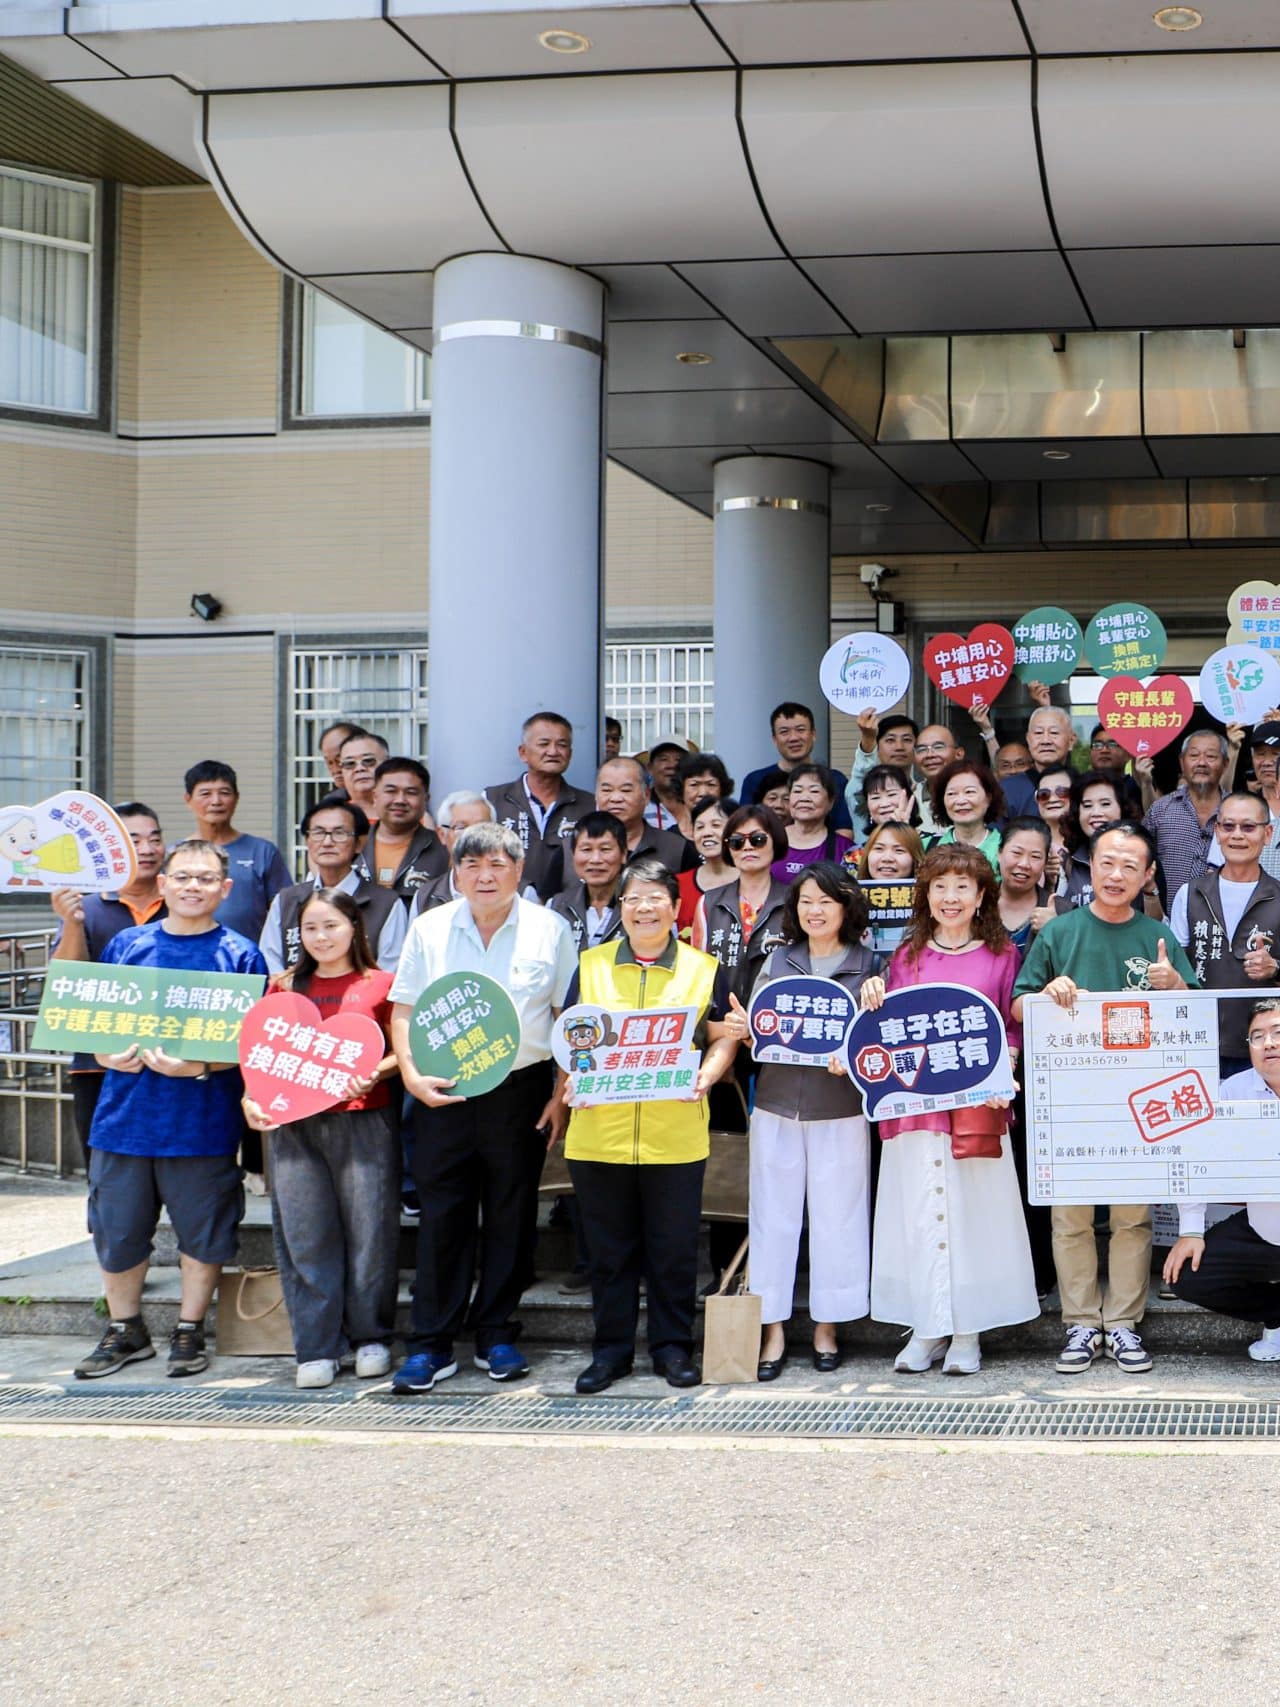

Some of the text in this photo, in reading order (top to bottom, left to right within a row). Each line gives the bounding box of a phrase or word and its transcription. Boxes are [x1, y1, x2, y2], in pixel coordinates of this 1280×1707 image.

[1014, 622, 1077, 642] 中埔貼心
[1095, 610, 1149, 630] 中埔用心
[1097, 624, 1151, 646] 長輩安心
[934, 639, 1004, 668] 中埔用心
[1014, 643, 1077, 665] 換照舒心
[1112, 640, 1140, 658] 換照
[938, 658, 1008, 690] 長輩安心
[832, 685, 899, 699] 中埔鄉公所
[1114, 690, 1175, 708] 守護長輩
[1106, 711, 1183, 729] 安全最給力
[861, 886, 915, 908] 守號
[416, 979, 481, 1029] 中埔用心
[775, 994, 848, 1017] 車子在走
[44, 1007, 243, 1043] 守護長輩安全最給力
[426, 1000, 492, 1050] 長輩安心
[623, 1017, 678, 1045] 強化
[760, 1014, 845, 1042] 停讓要有
[879, 1005, 989, 1045] 車子在走
[263, 1016, 364, 1069] 中埔有愛
[453, 1028, 489, 1062] 換照
[604, 1048, 682, 1070] 考照制度
[861, 1037, 990, 1078] 停讓要有
[1054, 1055, 1128, 1067] Q123456789
[245, 1044, 351, 1098] 換照無礙
[576, 1069, 693, 1094] 提升安全駕駛
[1140, 1085, 1203, 1129] 合格
[1192, 1165, 1208, 1175] 70
